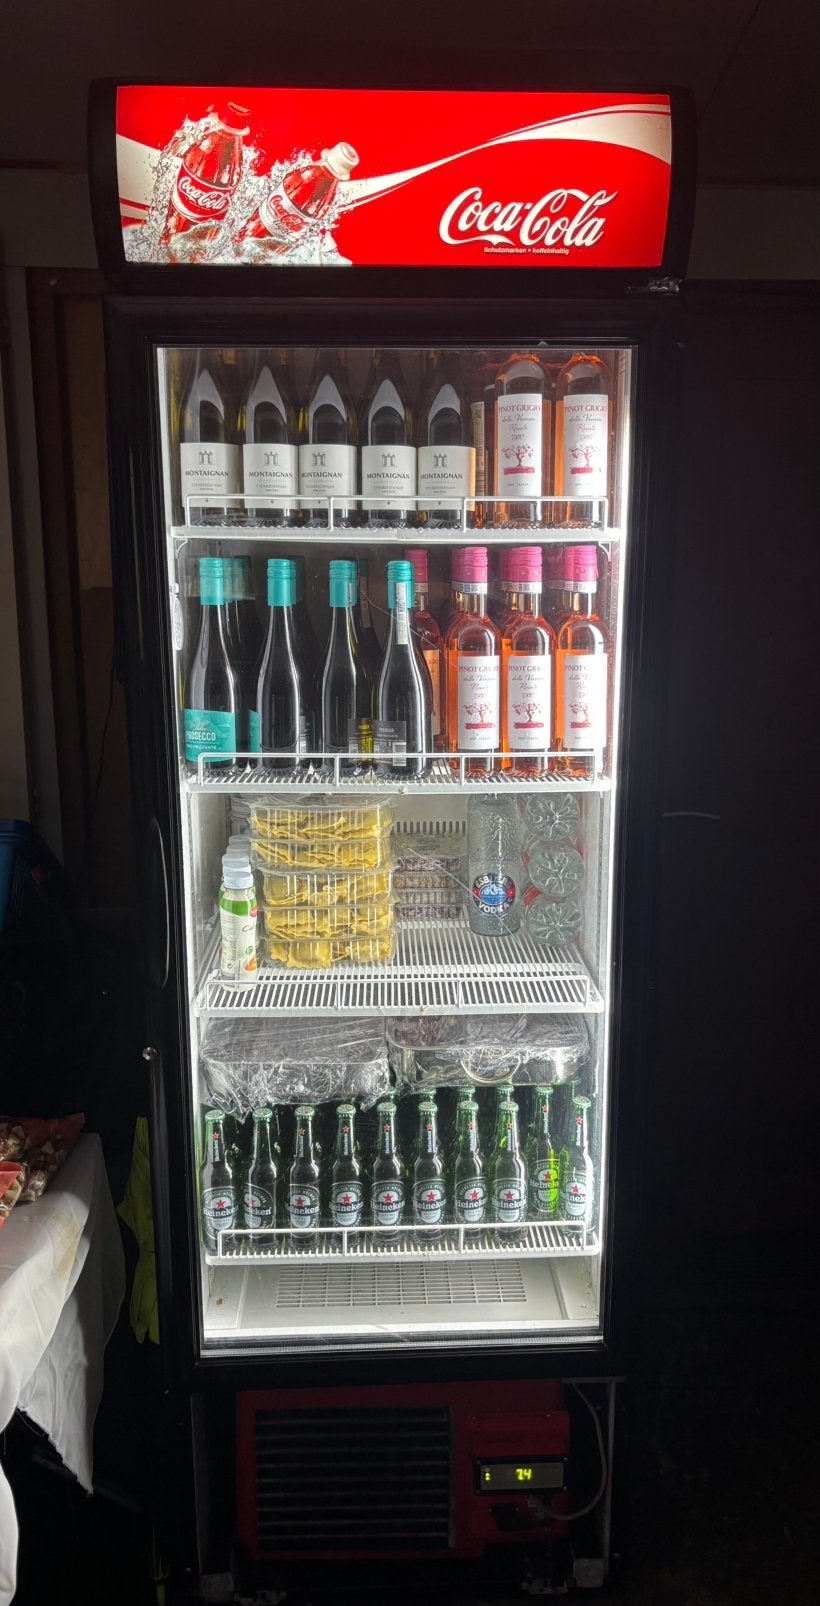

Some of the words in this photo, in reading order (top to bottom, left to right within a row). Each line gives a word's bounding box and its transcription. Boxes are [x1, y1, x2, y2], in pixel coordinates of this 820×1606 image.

[179, 176, 231, 210] Coca-Cola
[439, 187, 619, 247] Coca-Cola
[484, 246, 526, 254] Schutzmarken
[532, 247, 569, 256] koffeinhaltig
[498, 405, 516, 414] PINOT
[516, 405, 541, 413] GRIGIO
[565, 405, 584, 413] PINOT
[585, 405, 607, 413] GRIGIO
[184, 469, 230, 477] MONTAIGNAN
[366, 472, 410, 480] MONTAIGNAN
[458, 665, 478, 673] PINOT
[508, 665, 526, 673] PINOT
[564, 664, 583, 672] PINOT
[185, 731, 216, 741] PROSECCO
[479, 900, 510, 914] VODKA
[244, 1205, 272, 1216] ineken
